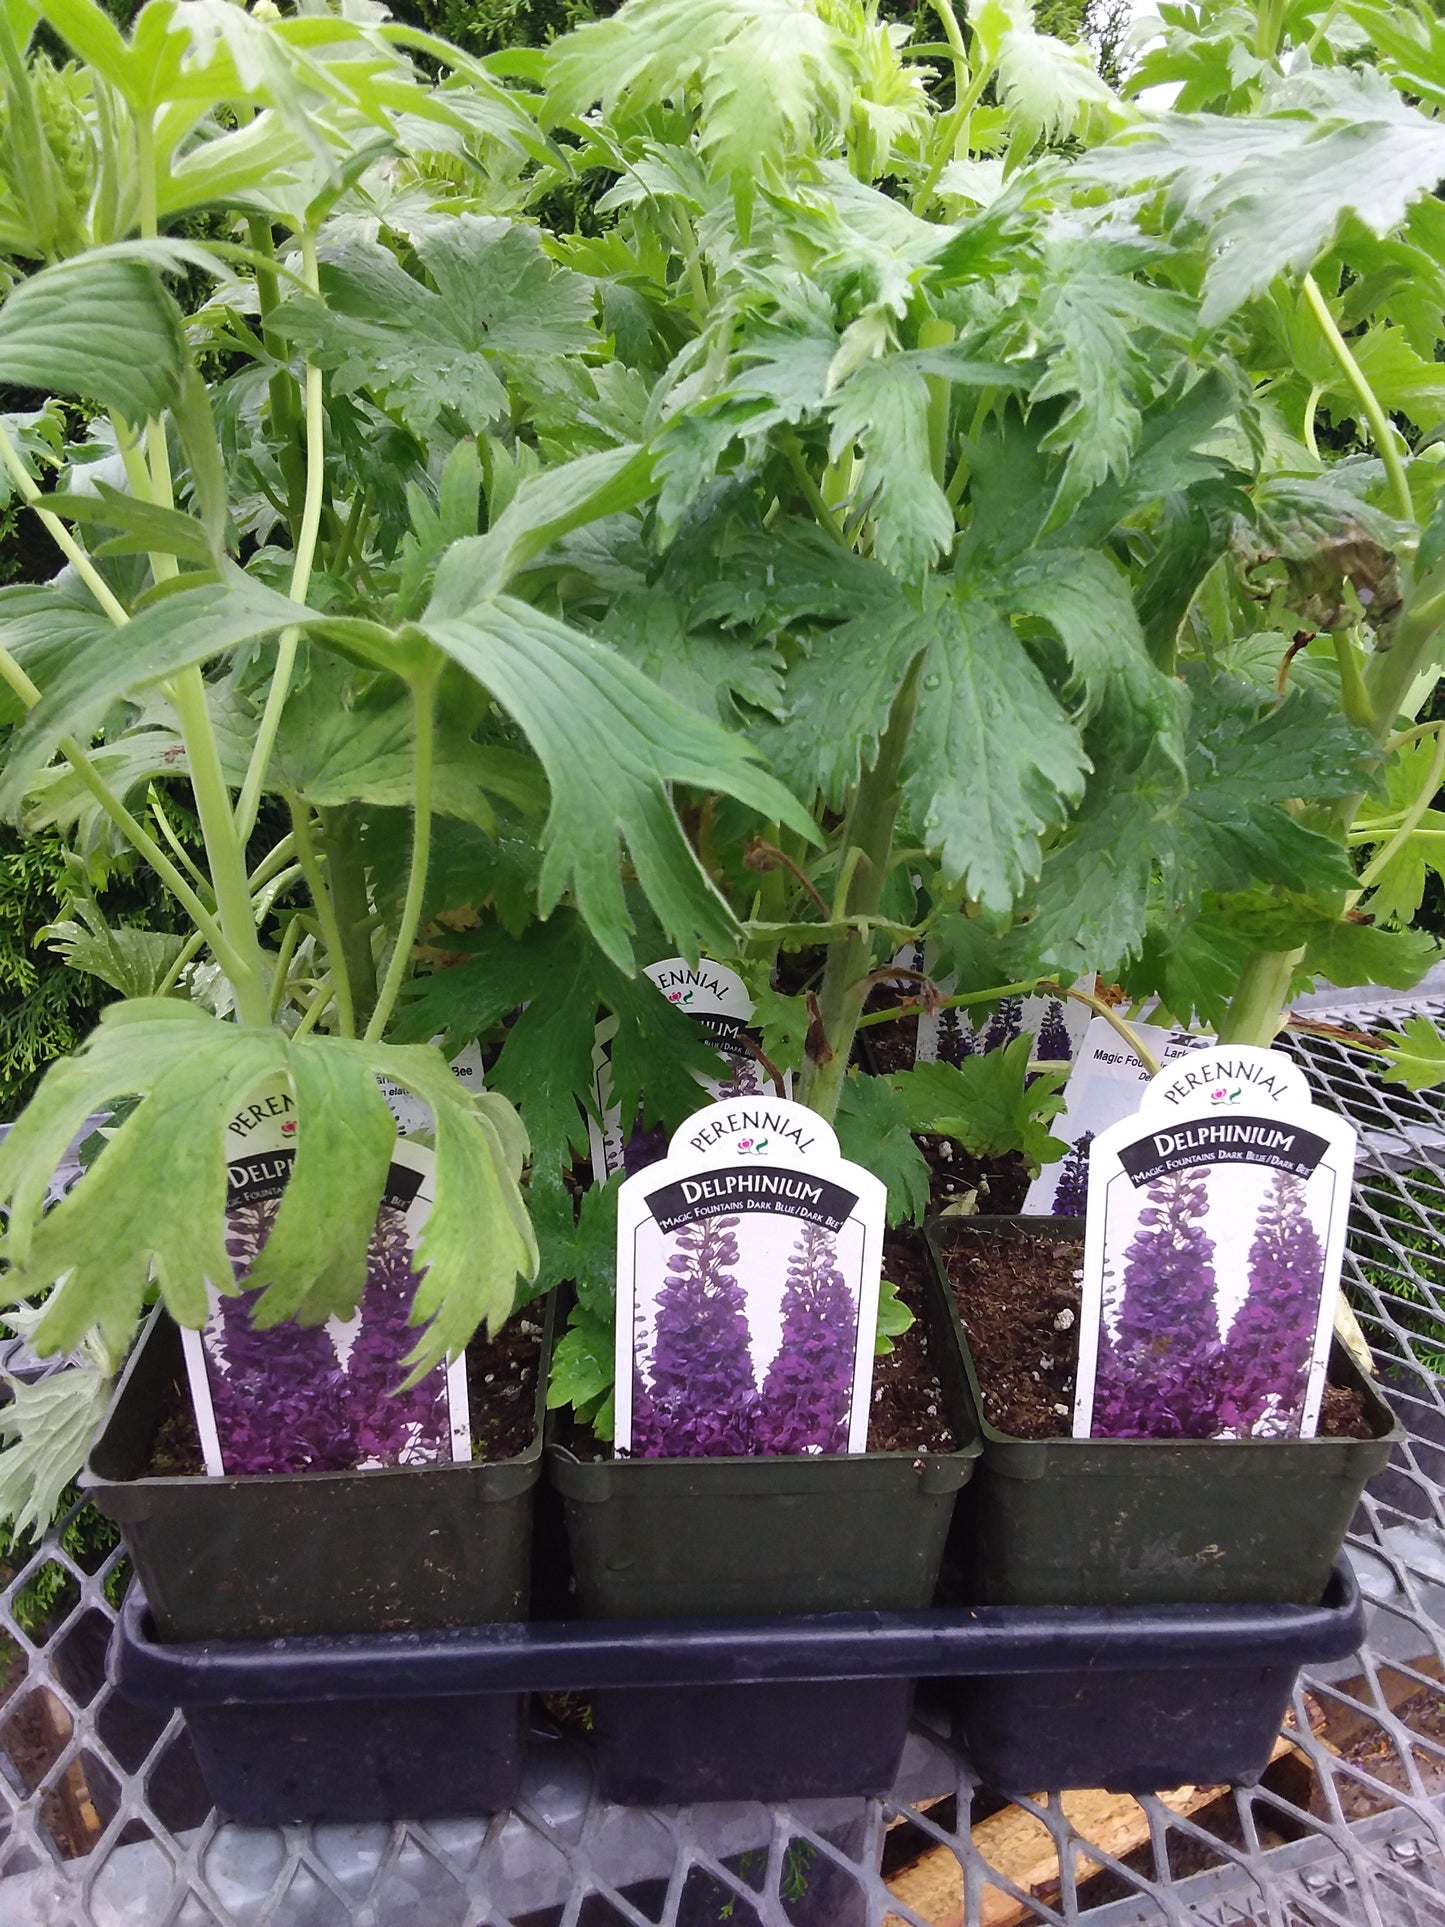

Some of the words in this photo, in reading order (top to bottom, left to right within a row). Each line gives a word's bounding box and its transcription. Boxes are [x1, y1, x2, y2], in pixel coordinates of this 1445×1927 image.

[657, 969, 730, 1001] ENNIAL
[451, 1066, 473, 1077] Bee
[1093, 1049, 1124, 1065] Magic
[1163, 1060, 1290, 1105] PERENNIAL
[690, 1111, 816, 1154] PERENNIAL
[1153, 1124, 1296, 1157] DELPHINIUM
[1166, 1152, 1216, 1170] FOUNTAINS
[1218, 1149, 1244, 1160] DARK
[680, 1174, 824, 1205] DELPHINIUM
[694, 1201, 744, 1217] FOUNTAINS
[747, 1199, 772, 1210] DARK
[775, 1201, 823, 1223] BLUE/DARK
